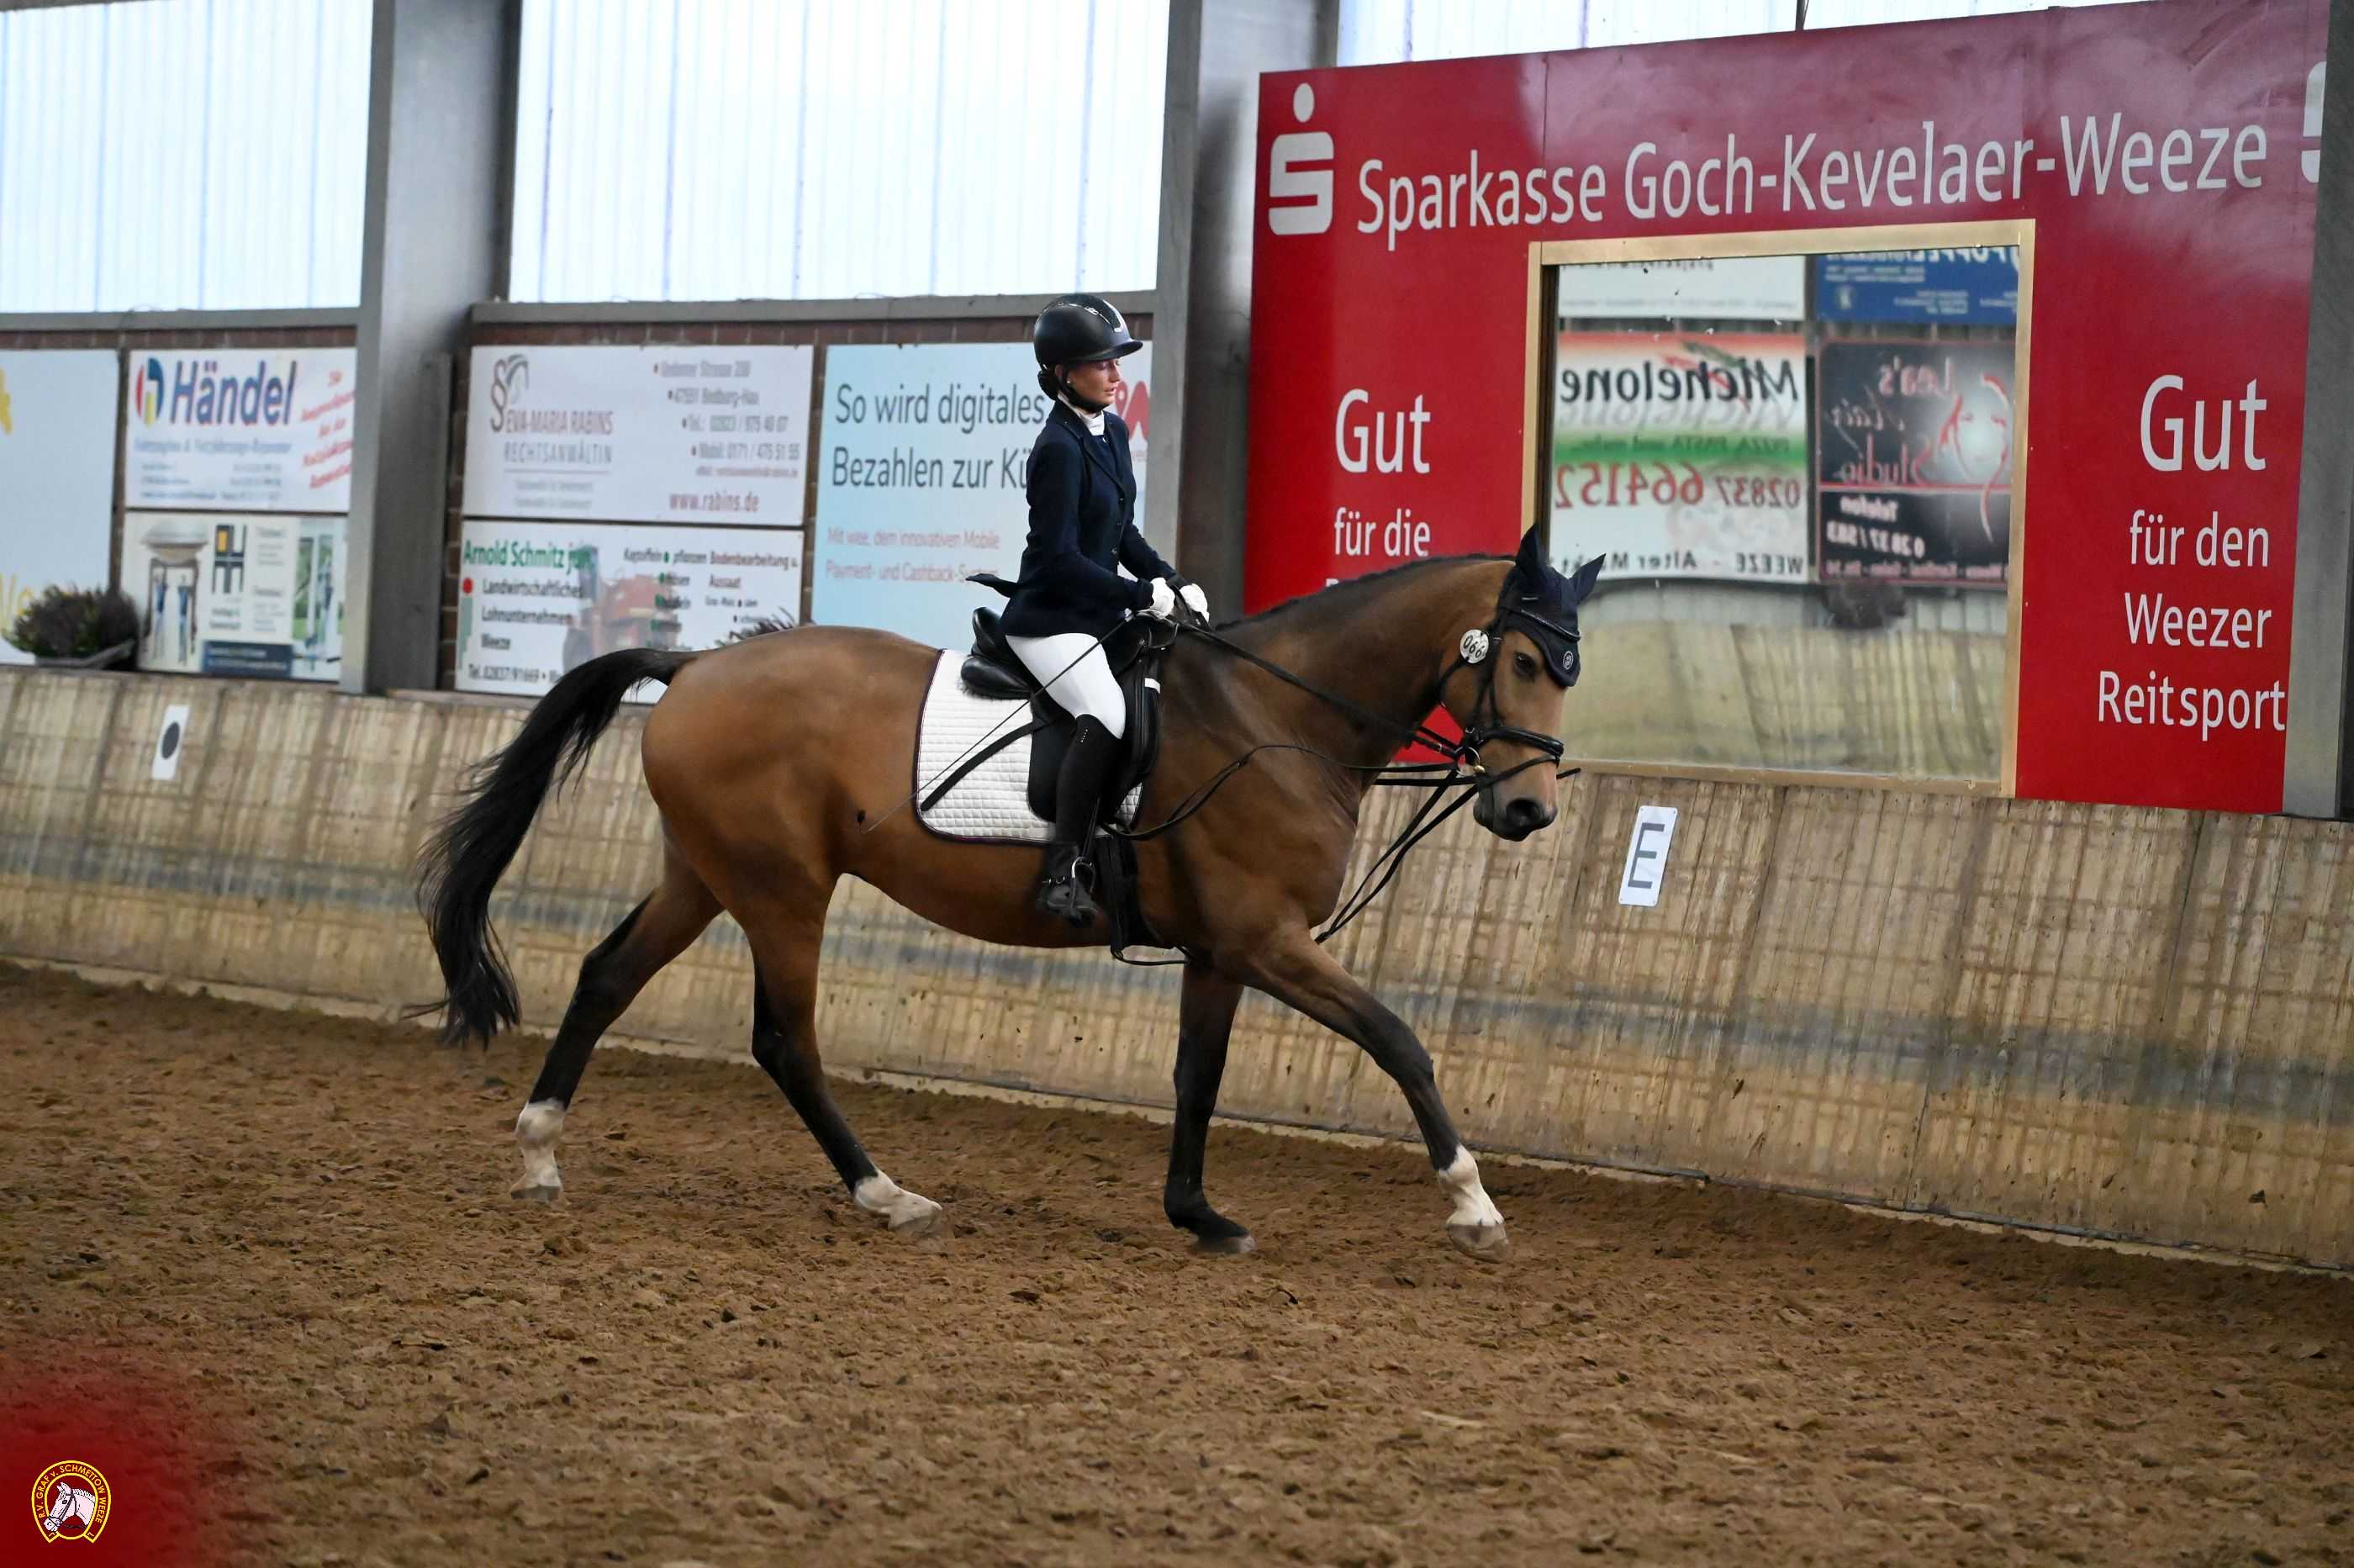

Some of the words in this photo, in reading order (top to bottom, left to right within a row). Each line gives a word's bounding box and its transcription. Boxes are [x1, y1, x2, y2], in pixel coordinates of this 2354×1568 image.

[1357, 149, 1606, 251] Sparkasse
[1624, 111, 2267, 220] Goch-Kevelaer-Weeze
[170, 360, 298, 425] Händel
[835, 384, 867, 424] So
[875, 383, 929, 424] wird
[938, 383, 1045, 434] digitales
[1335, 388, 1431, 473] Gut
[2140, 374, 2267, 472] Gut
[832, 446, 943, 488] Bezahlen
[953, 458, 994, 489] zur
[1001, 447, 1029, 490] Kü
[670, 490, 759, 512] www.rabins.de
[463, 539, 508, 566] Arnold
[510, 540, 565, 568] Schmitz
[827, 526, 844, 545] Mit
[874, 529, 898, 546] dem
[900, 530, 960, 547] innovativen
[963, 531, 1000, 549] Mobile
[1334, 507, 1376, 556] für
[1384, 508, 1431, 557] die
[2130, 509, 2185, 565] für
[2196, 510, 2269, 567] den
[879, 563, 899, 581] und
[2124, 591, 2272, 649] Weezer
[2098, 670, 2286, 742] Reitsport
[1628, 821, 1665, 890] E
